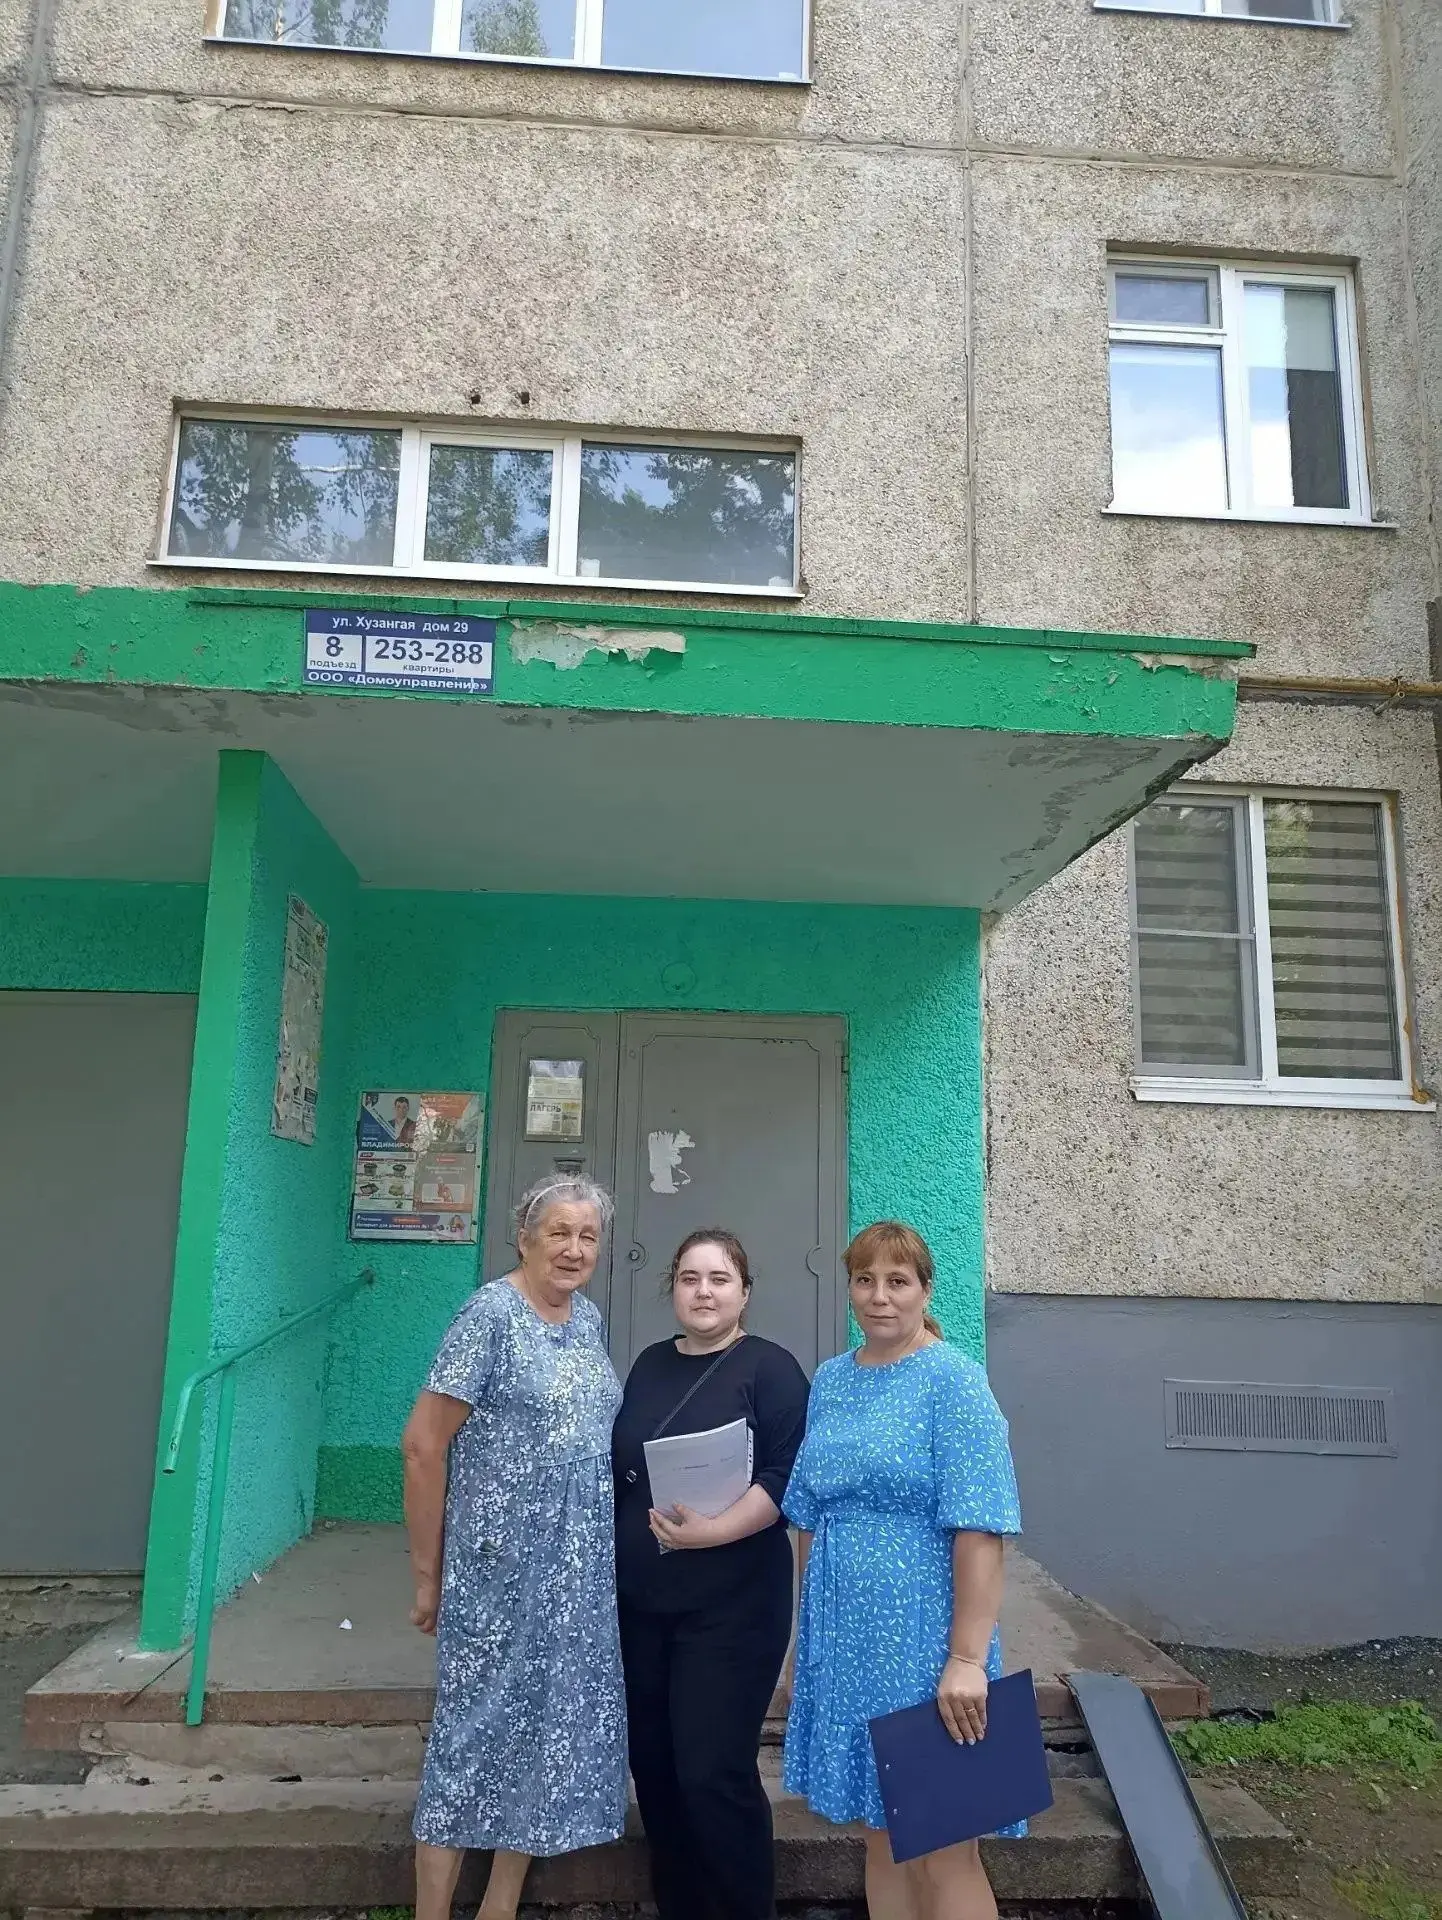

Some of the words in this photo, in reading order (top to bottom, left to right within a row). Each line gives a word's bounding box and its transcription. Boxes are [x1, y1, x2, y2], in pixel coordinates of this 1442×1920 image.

[332, 616, 352, 628] ул.
[356, 615, 416, 631] Хузангая
[422, 622, 450, 633] дом
[453, 621, 469, 633] 29
[326, 635, 343, 658] 8
[374, 638, 483, 665] 253-288
[309, 660, 357, 670] подъезд
[402, 663, 455, 674] квартиры
[308, 671, 344, 683] ООО
[348, 673, 488, 690] «Домоуправление»
[529, 1103, 562, 1113] ЛАГЕРЬ
